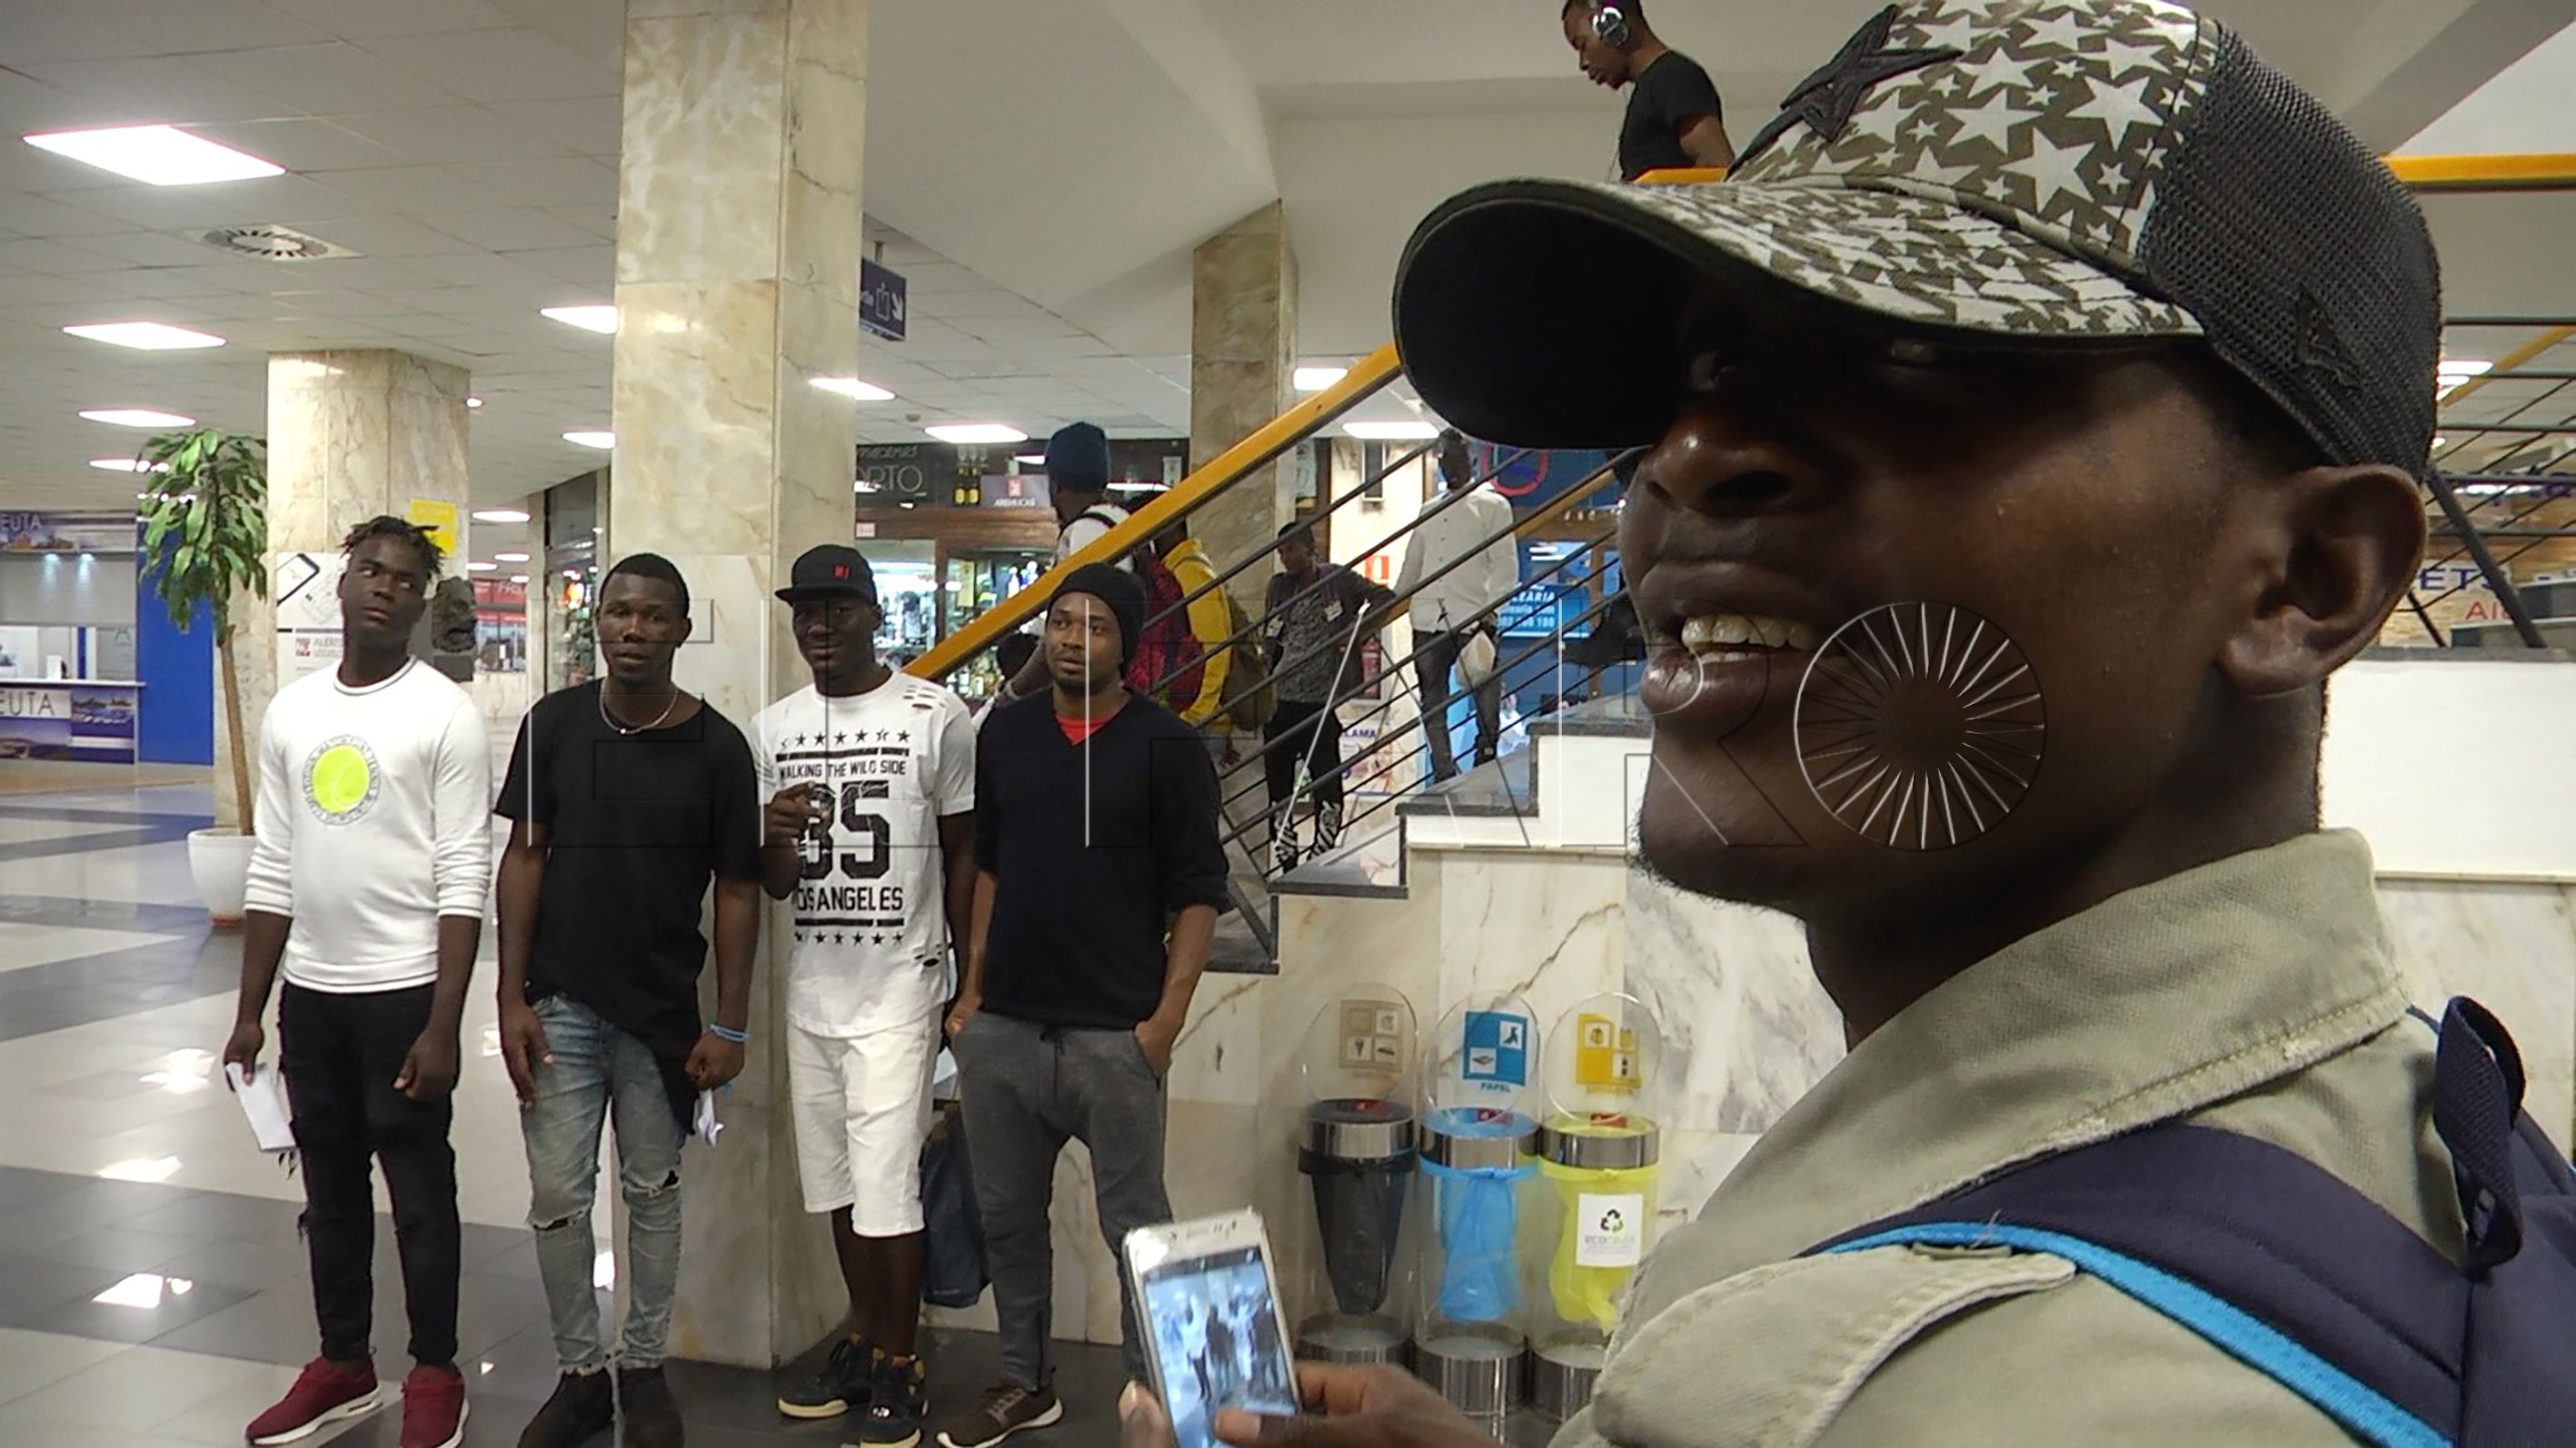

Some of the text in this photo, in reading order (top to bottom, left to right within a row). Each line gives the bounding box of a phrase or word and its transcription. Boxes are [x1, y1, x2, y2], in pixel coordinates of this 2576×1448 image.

[779, 764, 822, 779] WALKING
[827, 763, 847, 777] THE
[880, 759, 906, 775] SIDE
[817, 887, 904, 912] ANGELES
[1480, 1082, 1511, 1093] PAPEL
